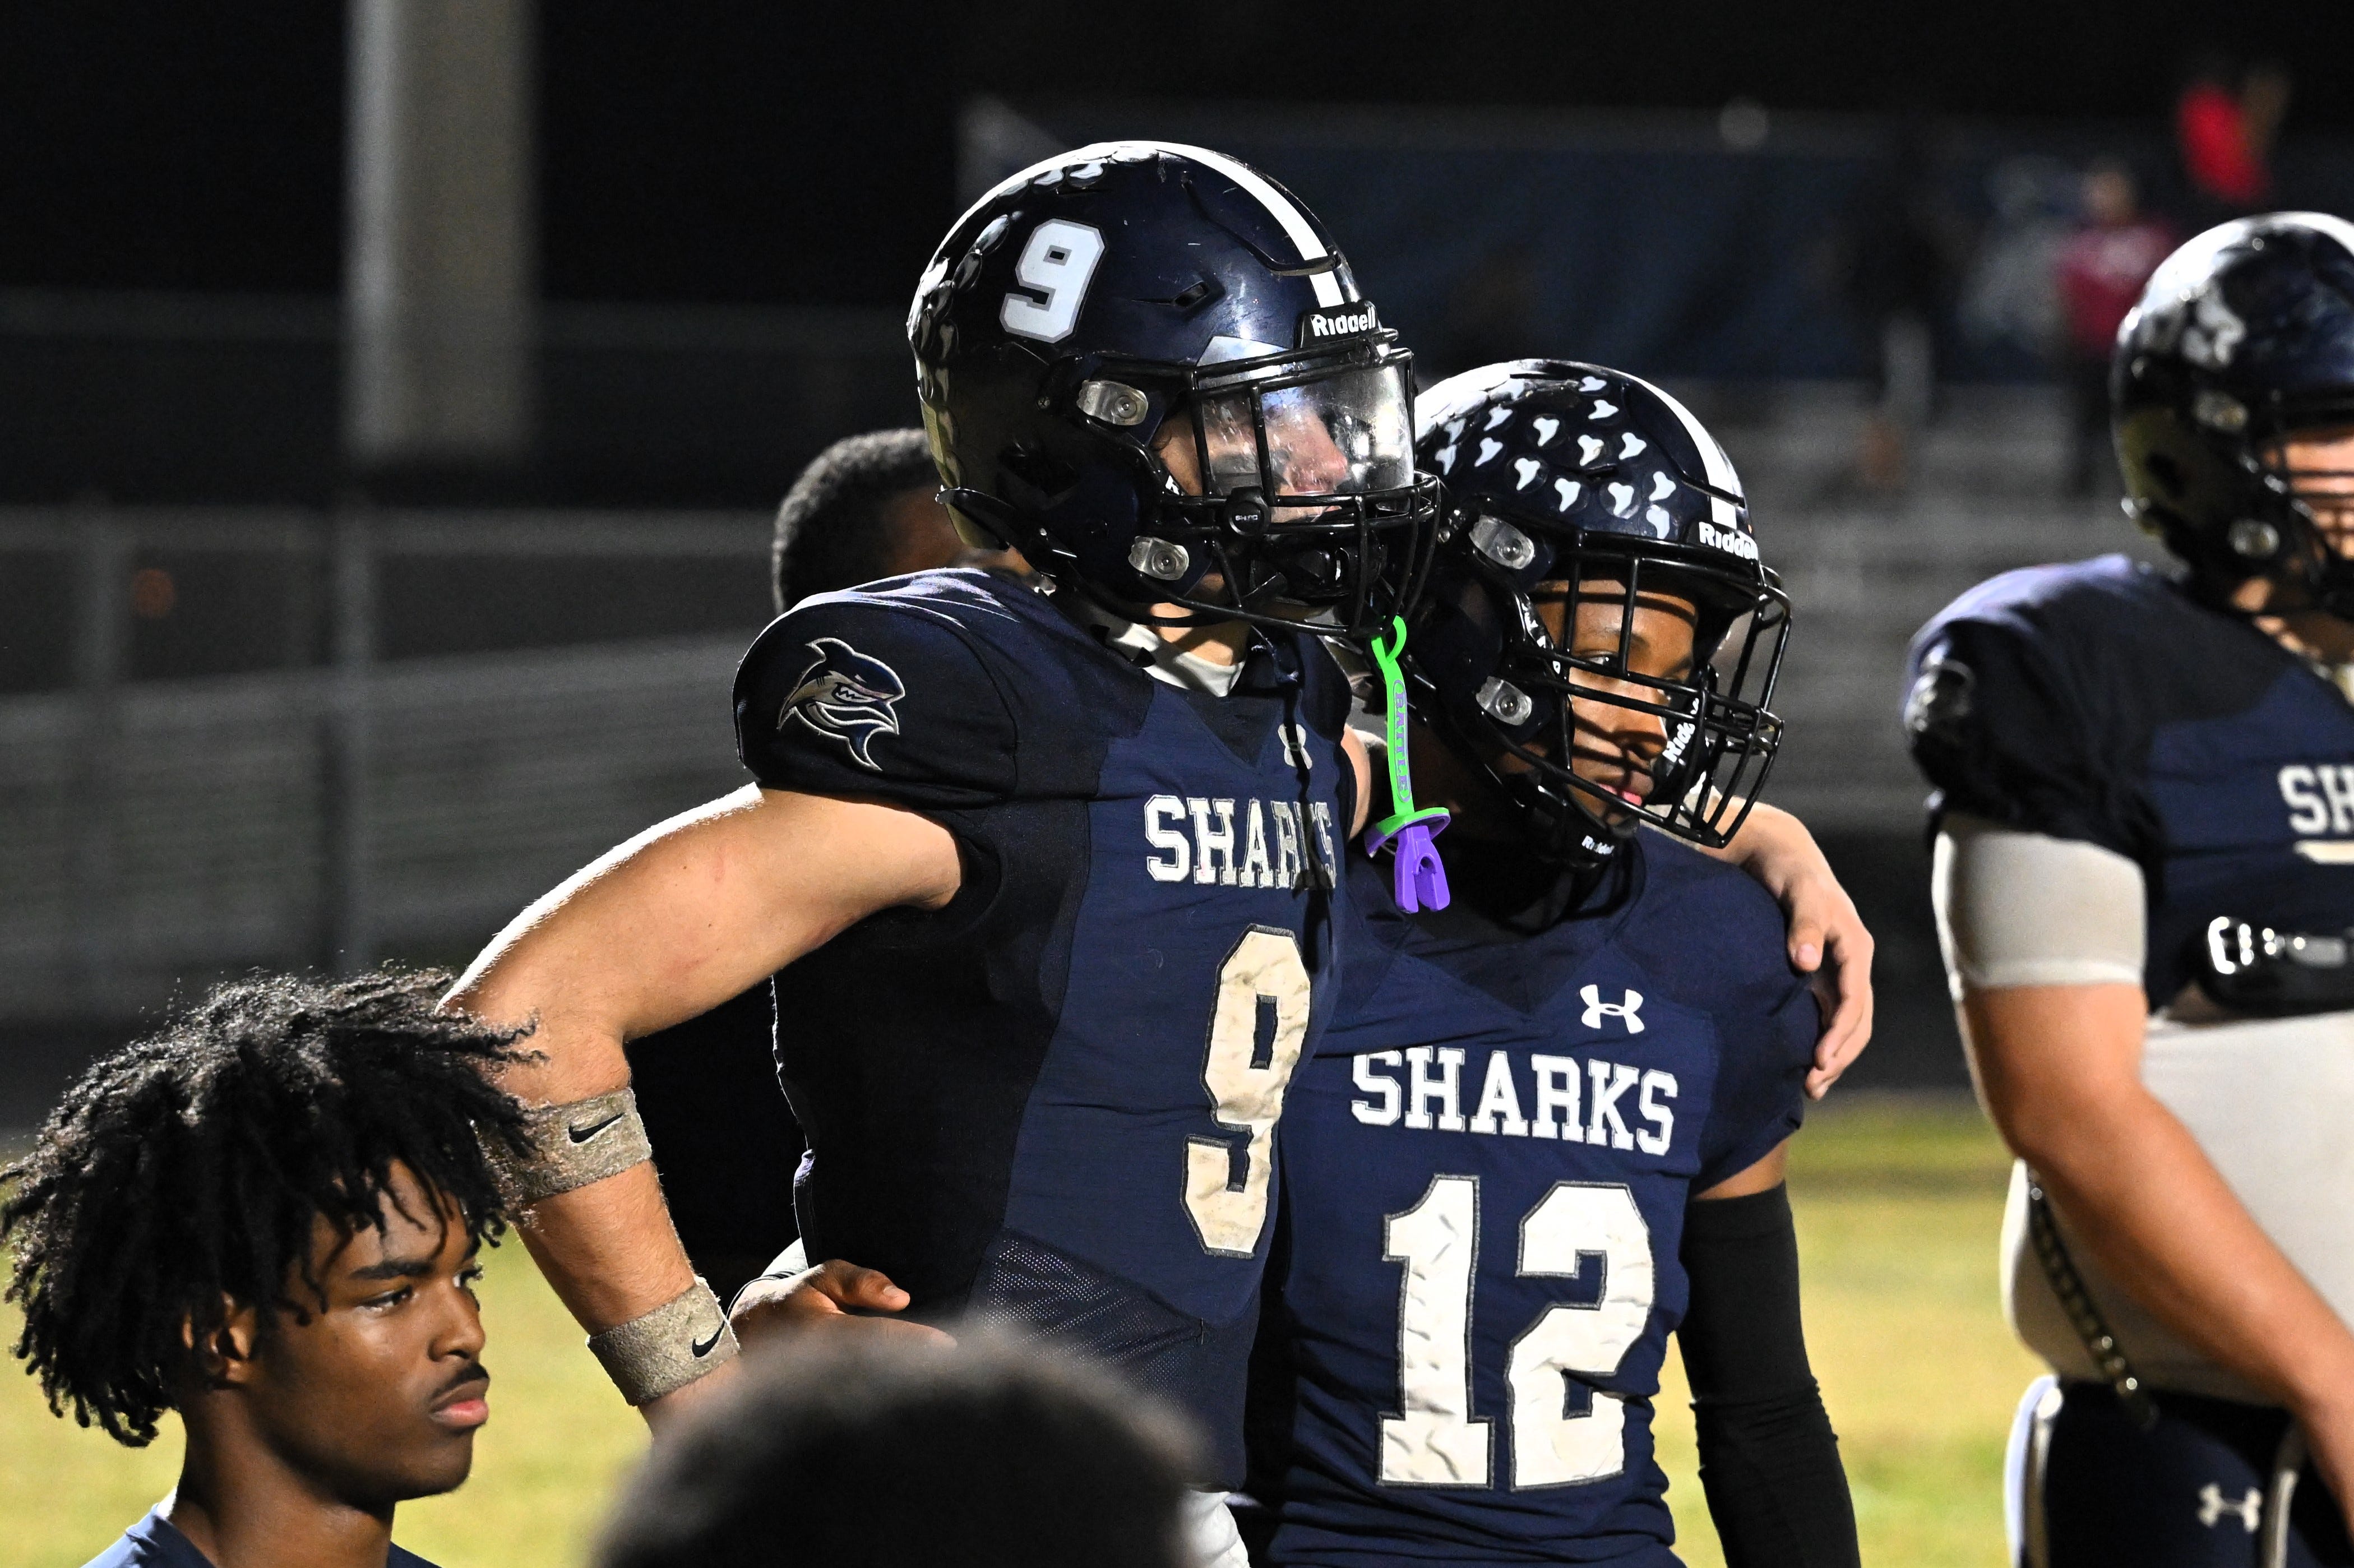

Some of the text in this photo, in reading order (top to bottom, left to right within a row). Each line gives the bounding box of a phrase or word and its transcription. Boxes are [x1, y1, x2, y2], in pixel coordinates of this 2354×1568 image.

[999, 218, 1105, 344] 9
[1310, 306, 1376, 336] Riddell
[1699, 521, 1759, 560] Riddell
[1395, 692, 1408, 790] BATTLE
[1180, 923, 1311, 1259] 9
[1351, 1045, 1678, 1156] SHARKS
[1376, 1174, 1655, 1492] 12
